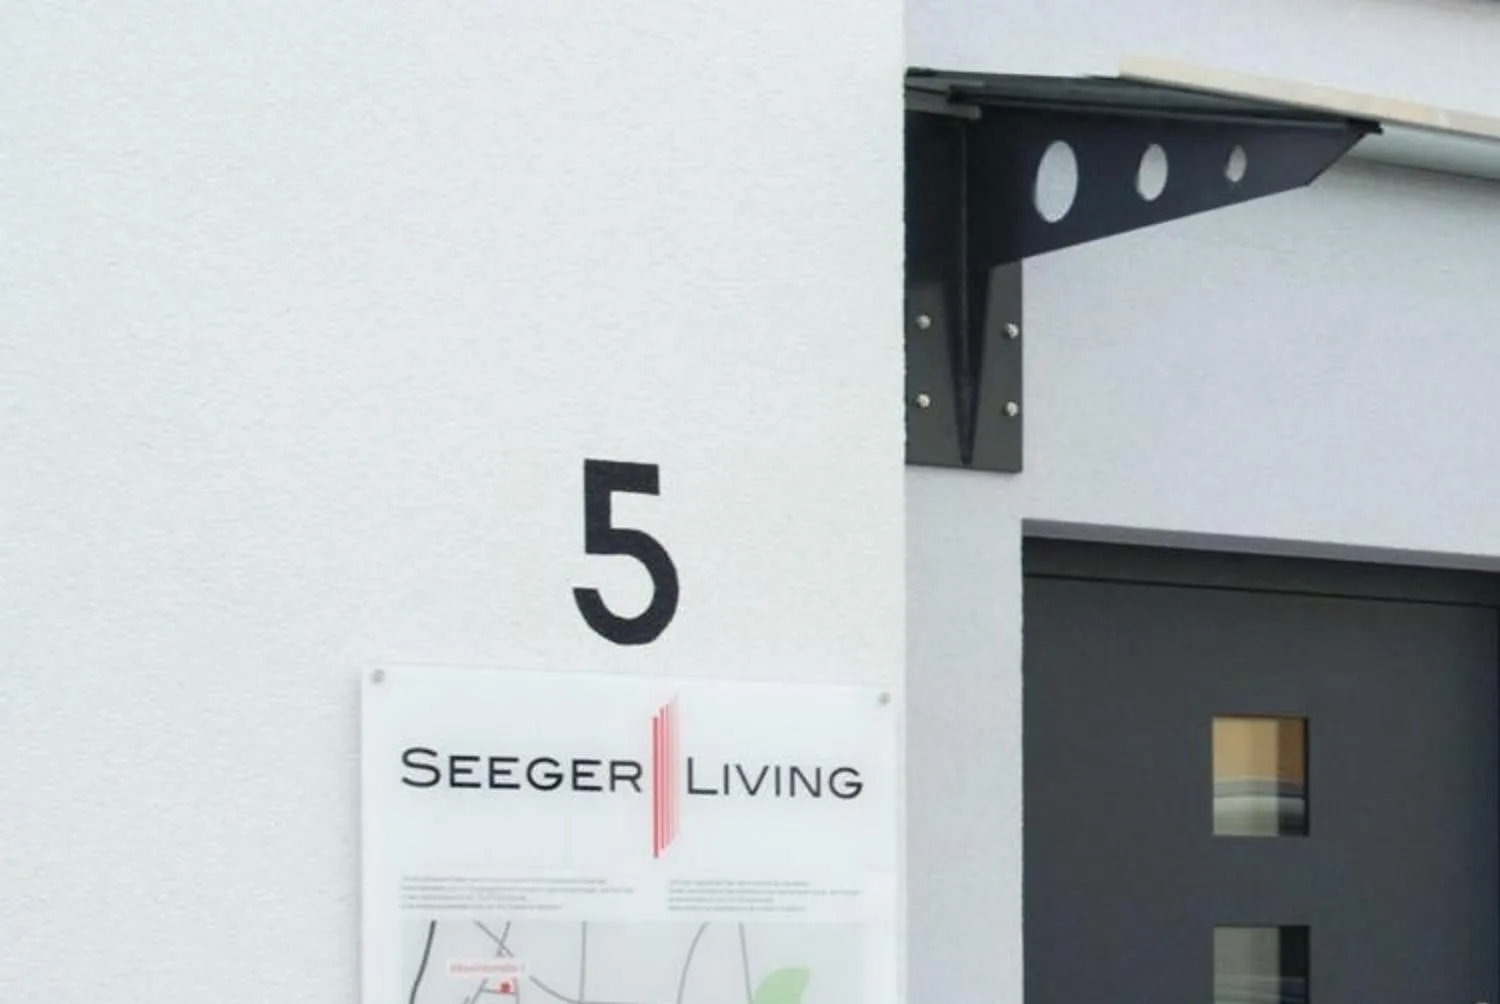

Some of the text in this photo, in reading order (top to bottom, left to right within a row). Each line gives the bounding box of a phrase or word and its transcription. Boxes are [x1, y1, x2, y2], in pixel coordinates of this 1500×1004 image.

[573, 458, 680, 646] 5
[401, 746, 864, 800] SEEGER LIVING
